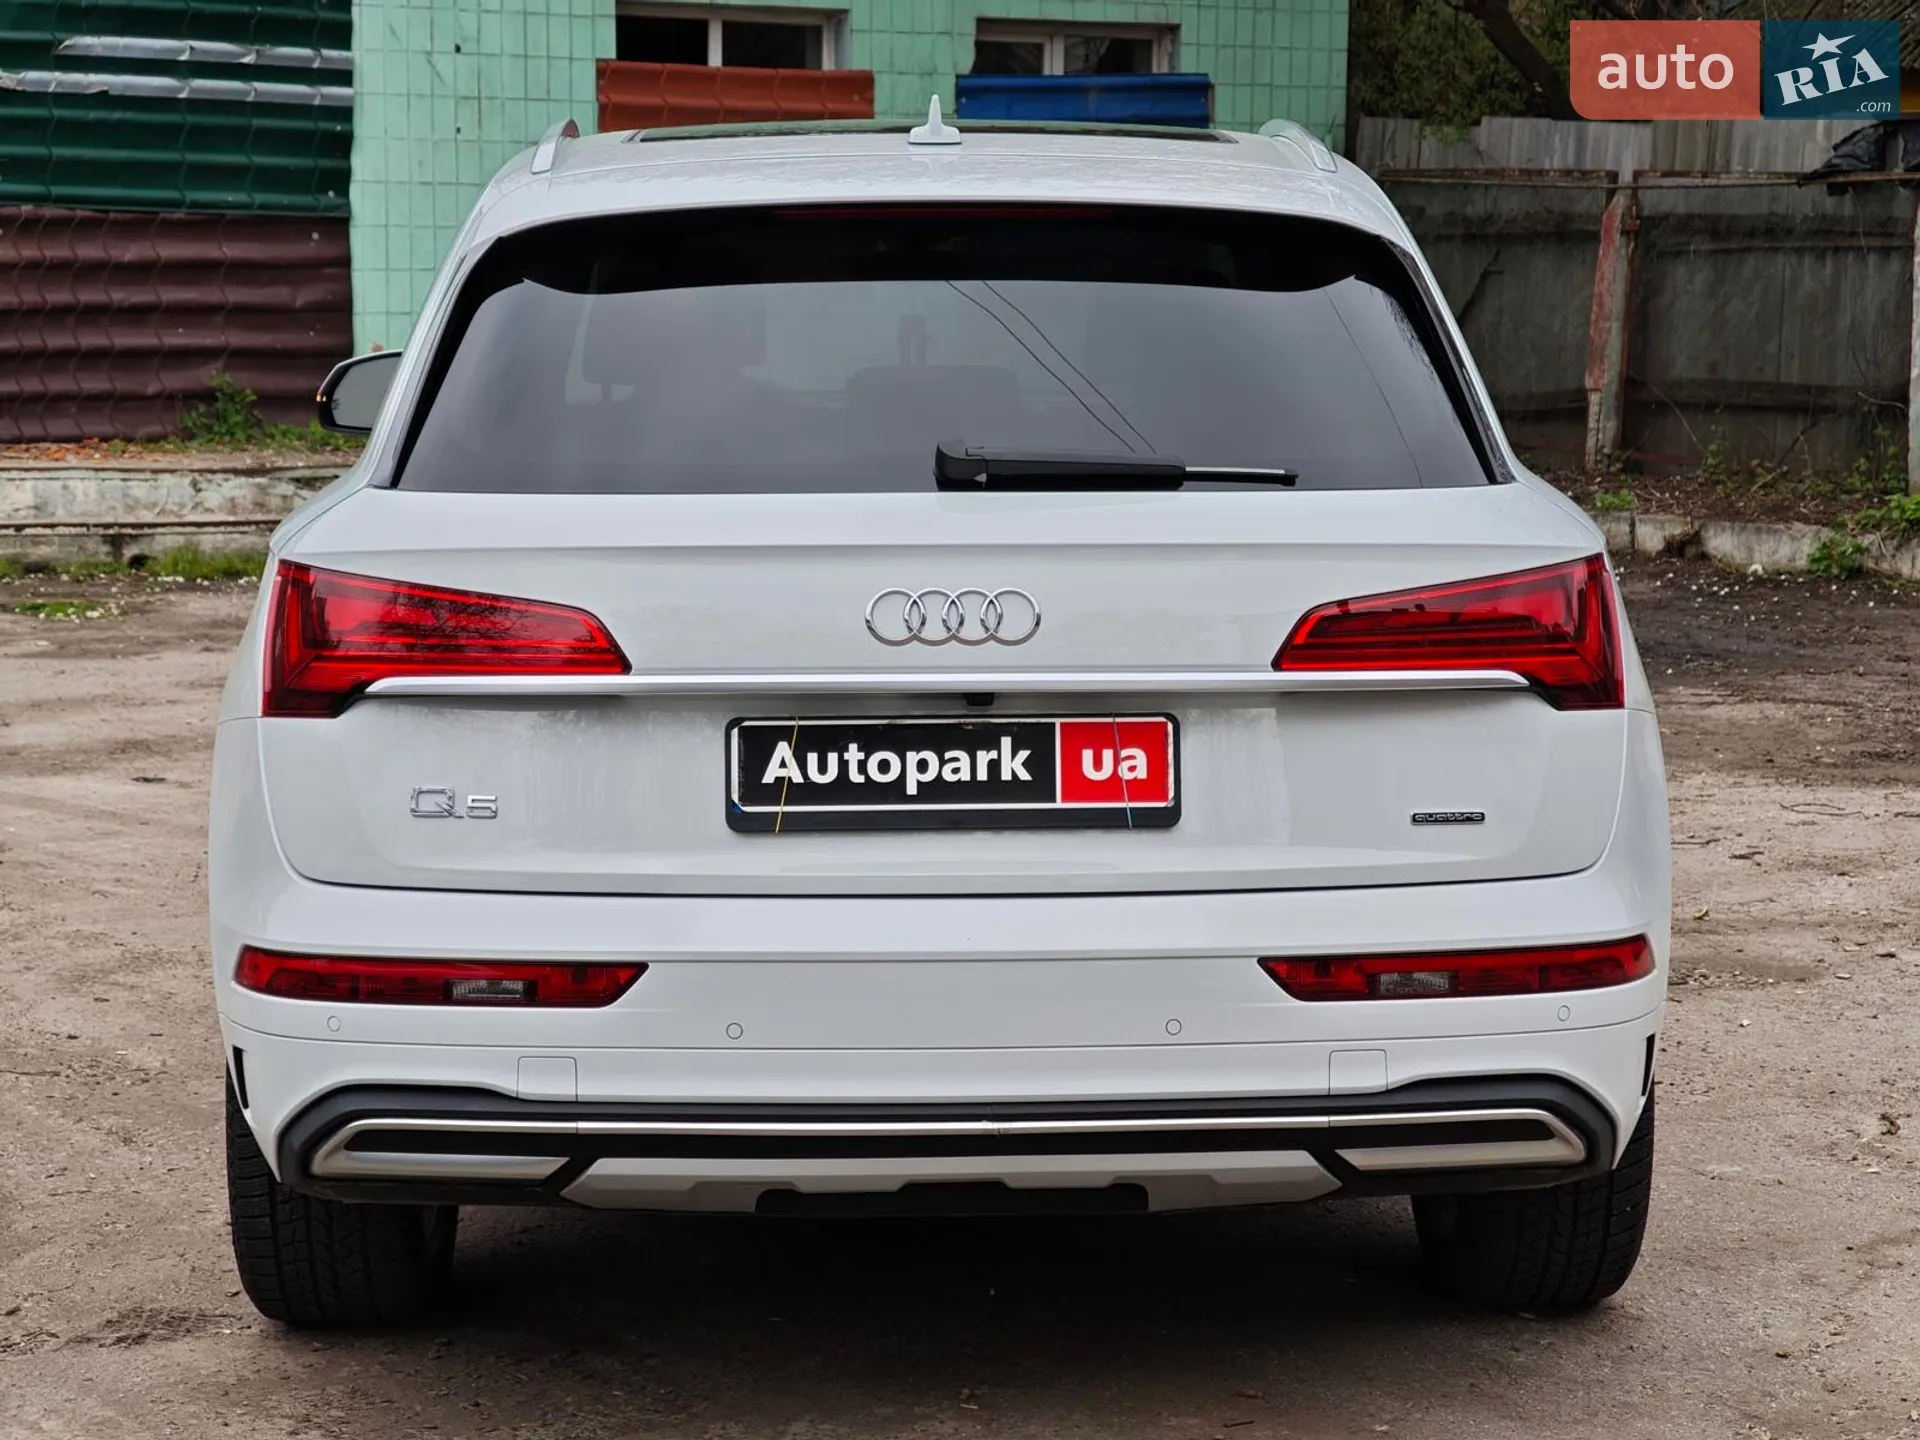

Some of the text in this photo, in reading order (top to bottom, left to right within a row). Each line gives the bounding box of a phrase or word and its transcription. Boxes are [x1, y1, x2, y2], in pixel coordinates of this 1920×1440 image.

[761, 736, 1148, 796] Autopark ua
[410, 786, 498, 819] Q5
[1413, 812, 1483, 822] quattro
